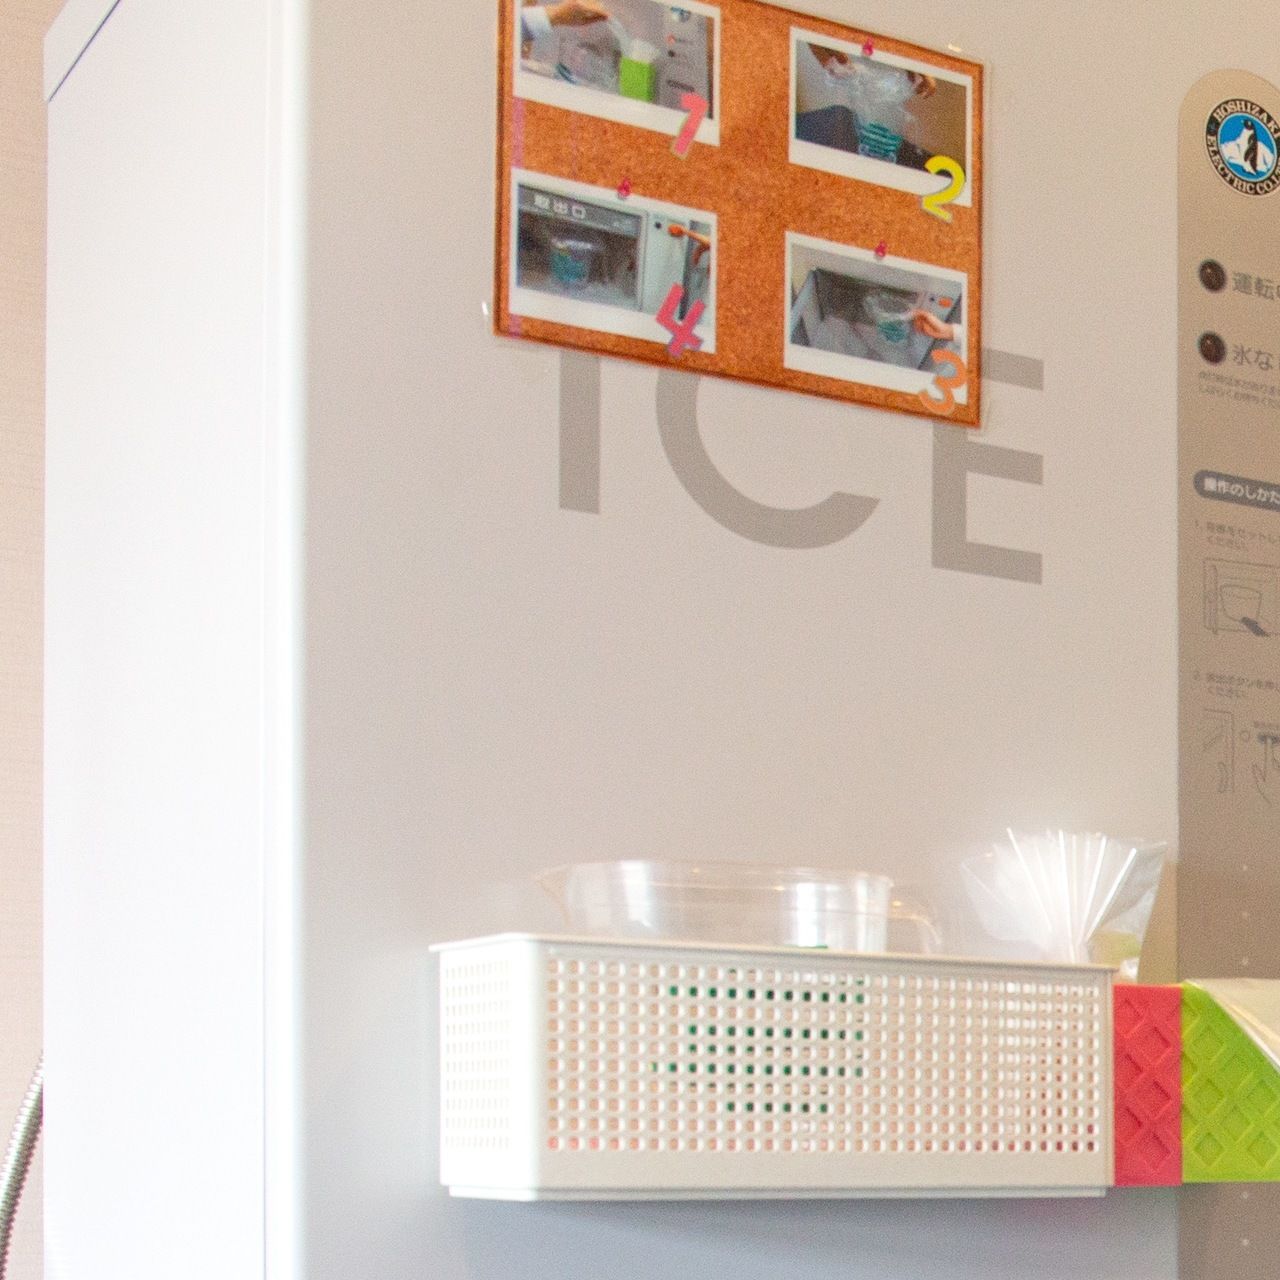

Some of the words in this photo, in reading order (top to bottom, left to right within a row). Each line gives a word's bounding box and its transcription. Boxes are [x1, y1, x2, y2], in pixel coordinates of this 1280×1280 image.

[669, 93, 707, 158] 1
[922, 156, 967, 222] 2
[656, 283, 705, 358] 4
[919, 350, 967, 414] 3
